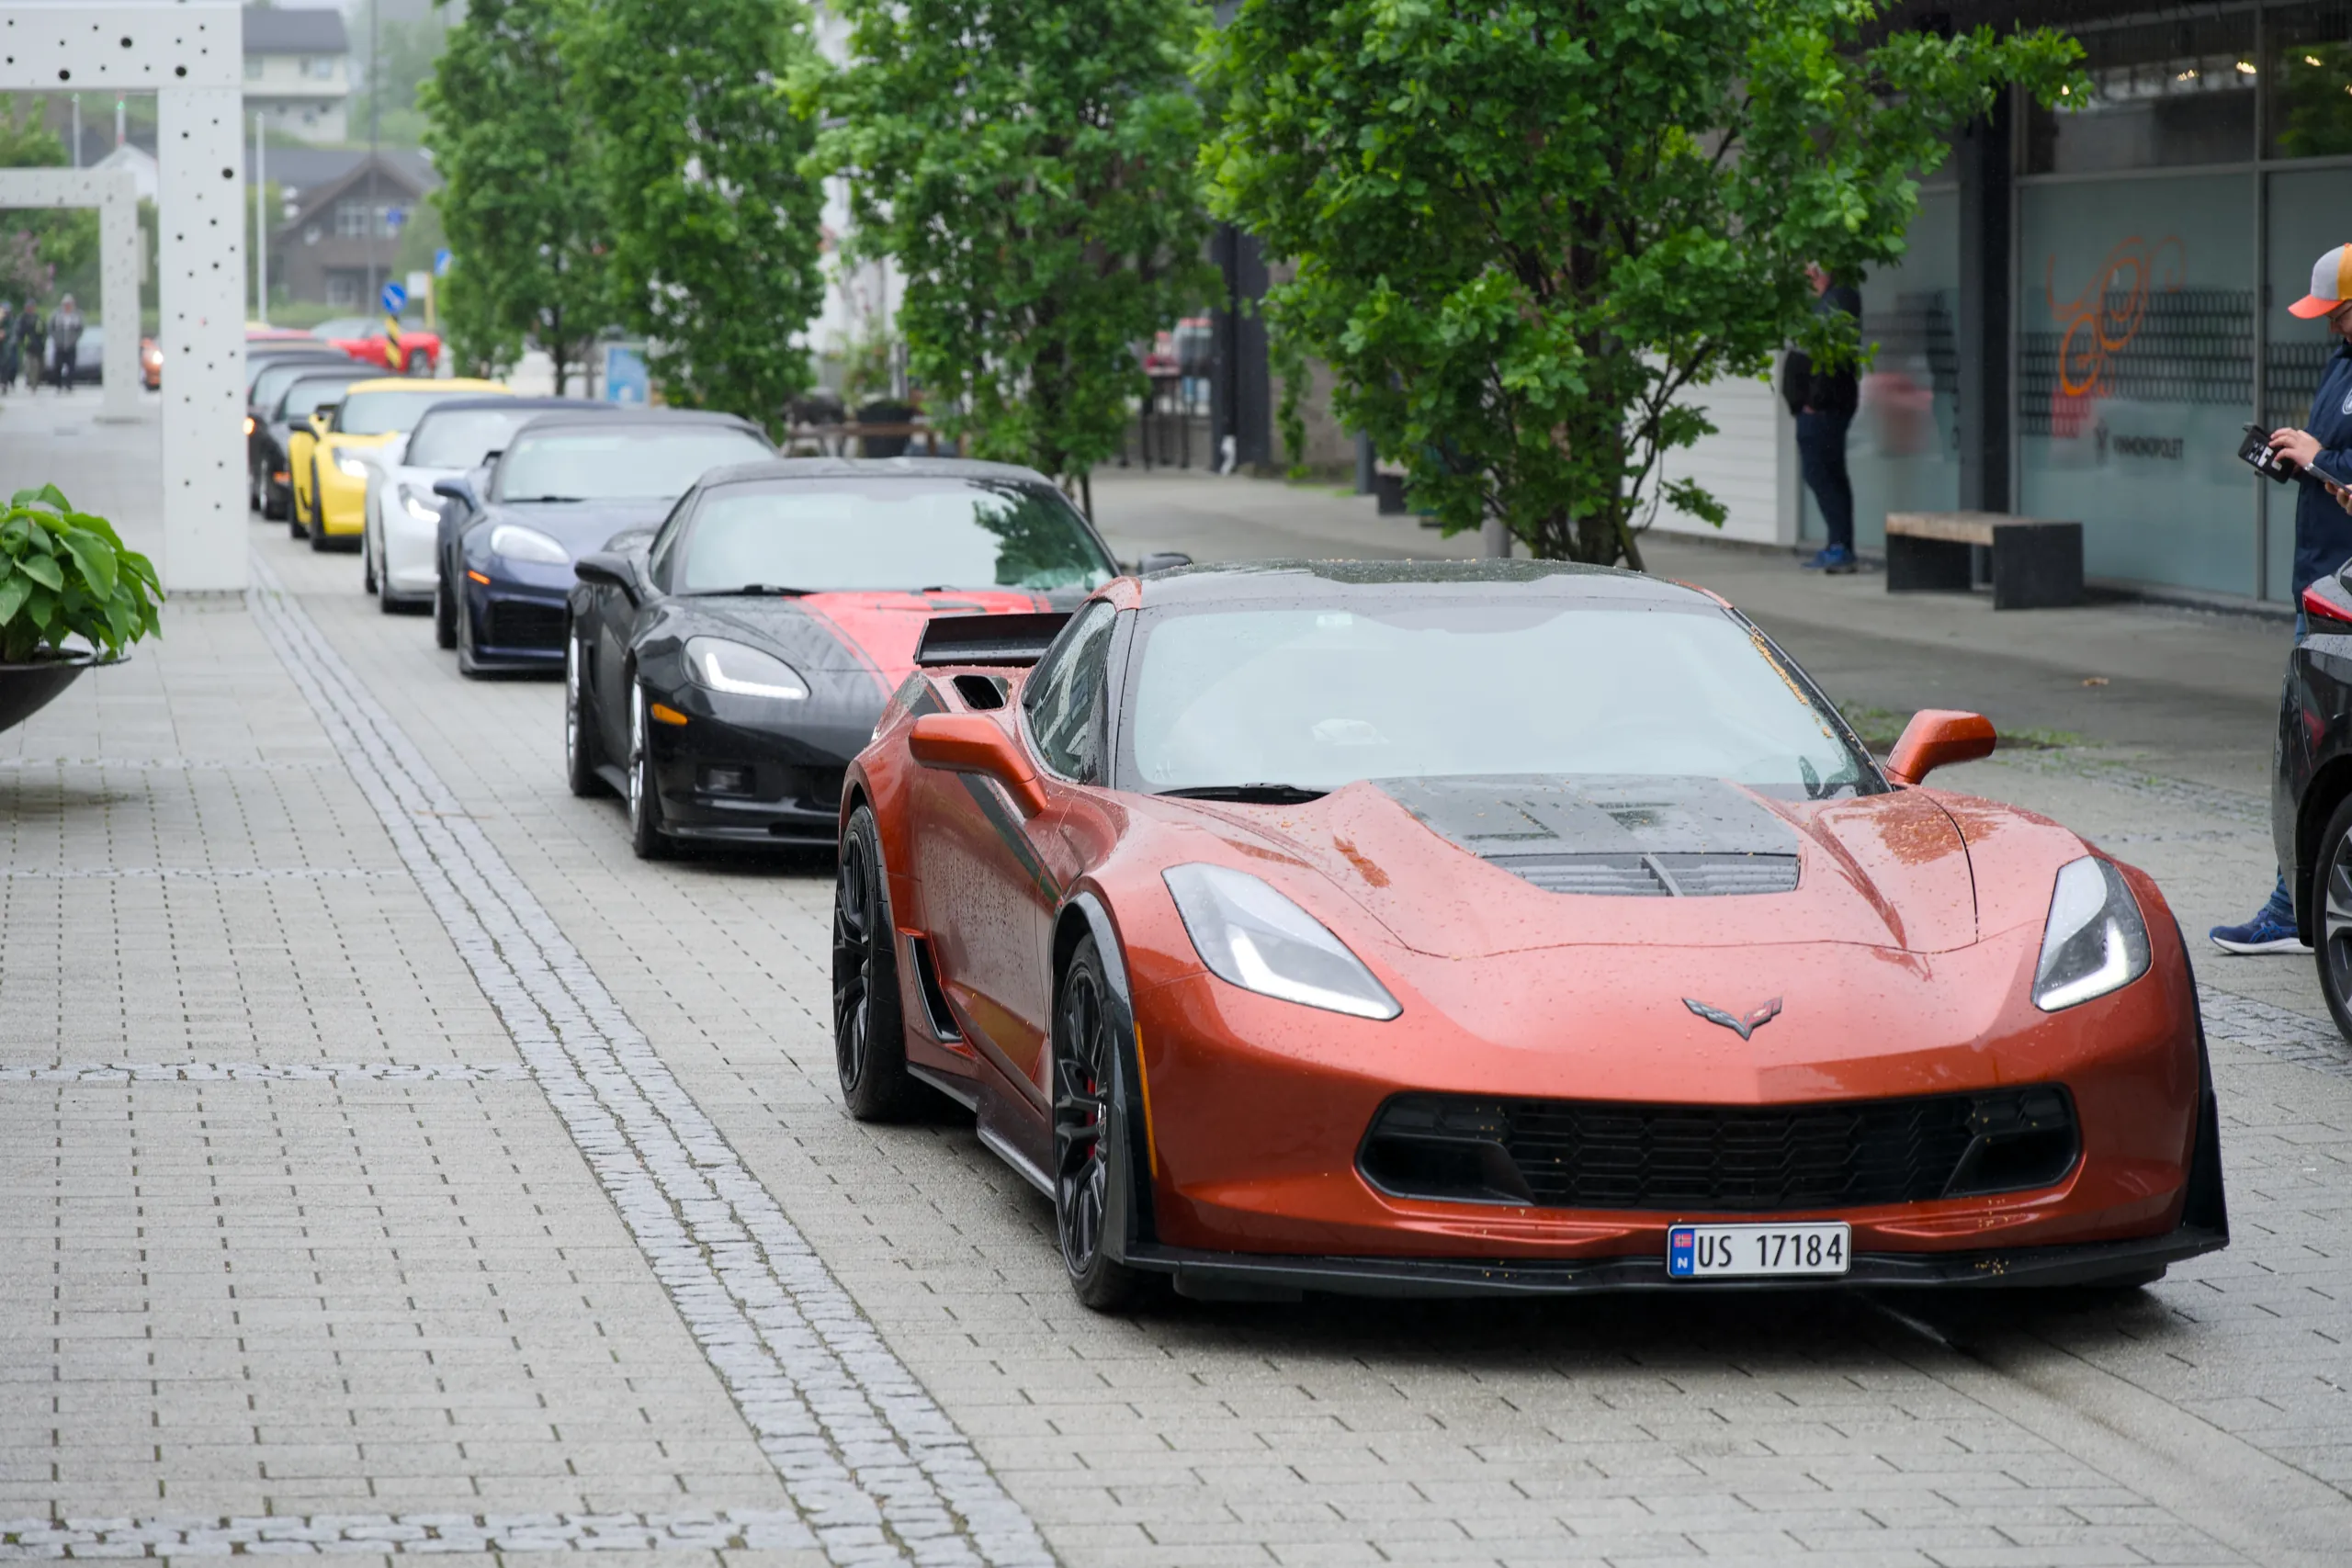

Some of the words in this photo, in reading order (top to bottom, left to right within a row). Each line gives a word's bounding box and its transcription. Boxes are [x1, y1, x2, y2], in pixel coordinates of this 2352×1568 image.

[1677, 1257, 1689, 1269] N
[1698, 1235, 1733, 1269] US
[1756, 1233, 1843, 1268] 17184
